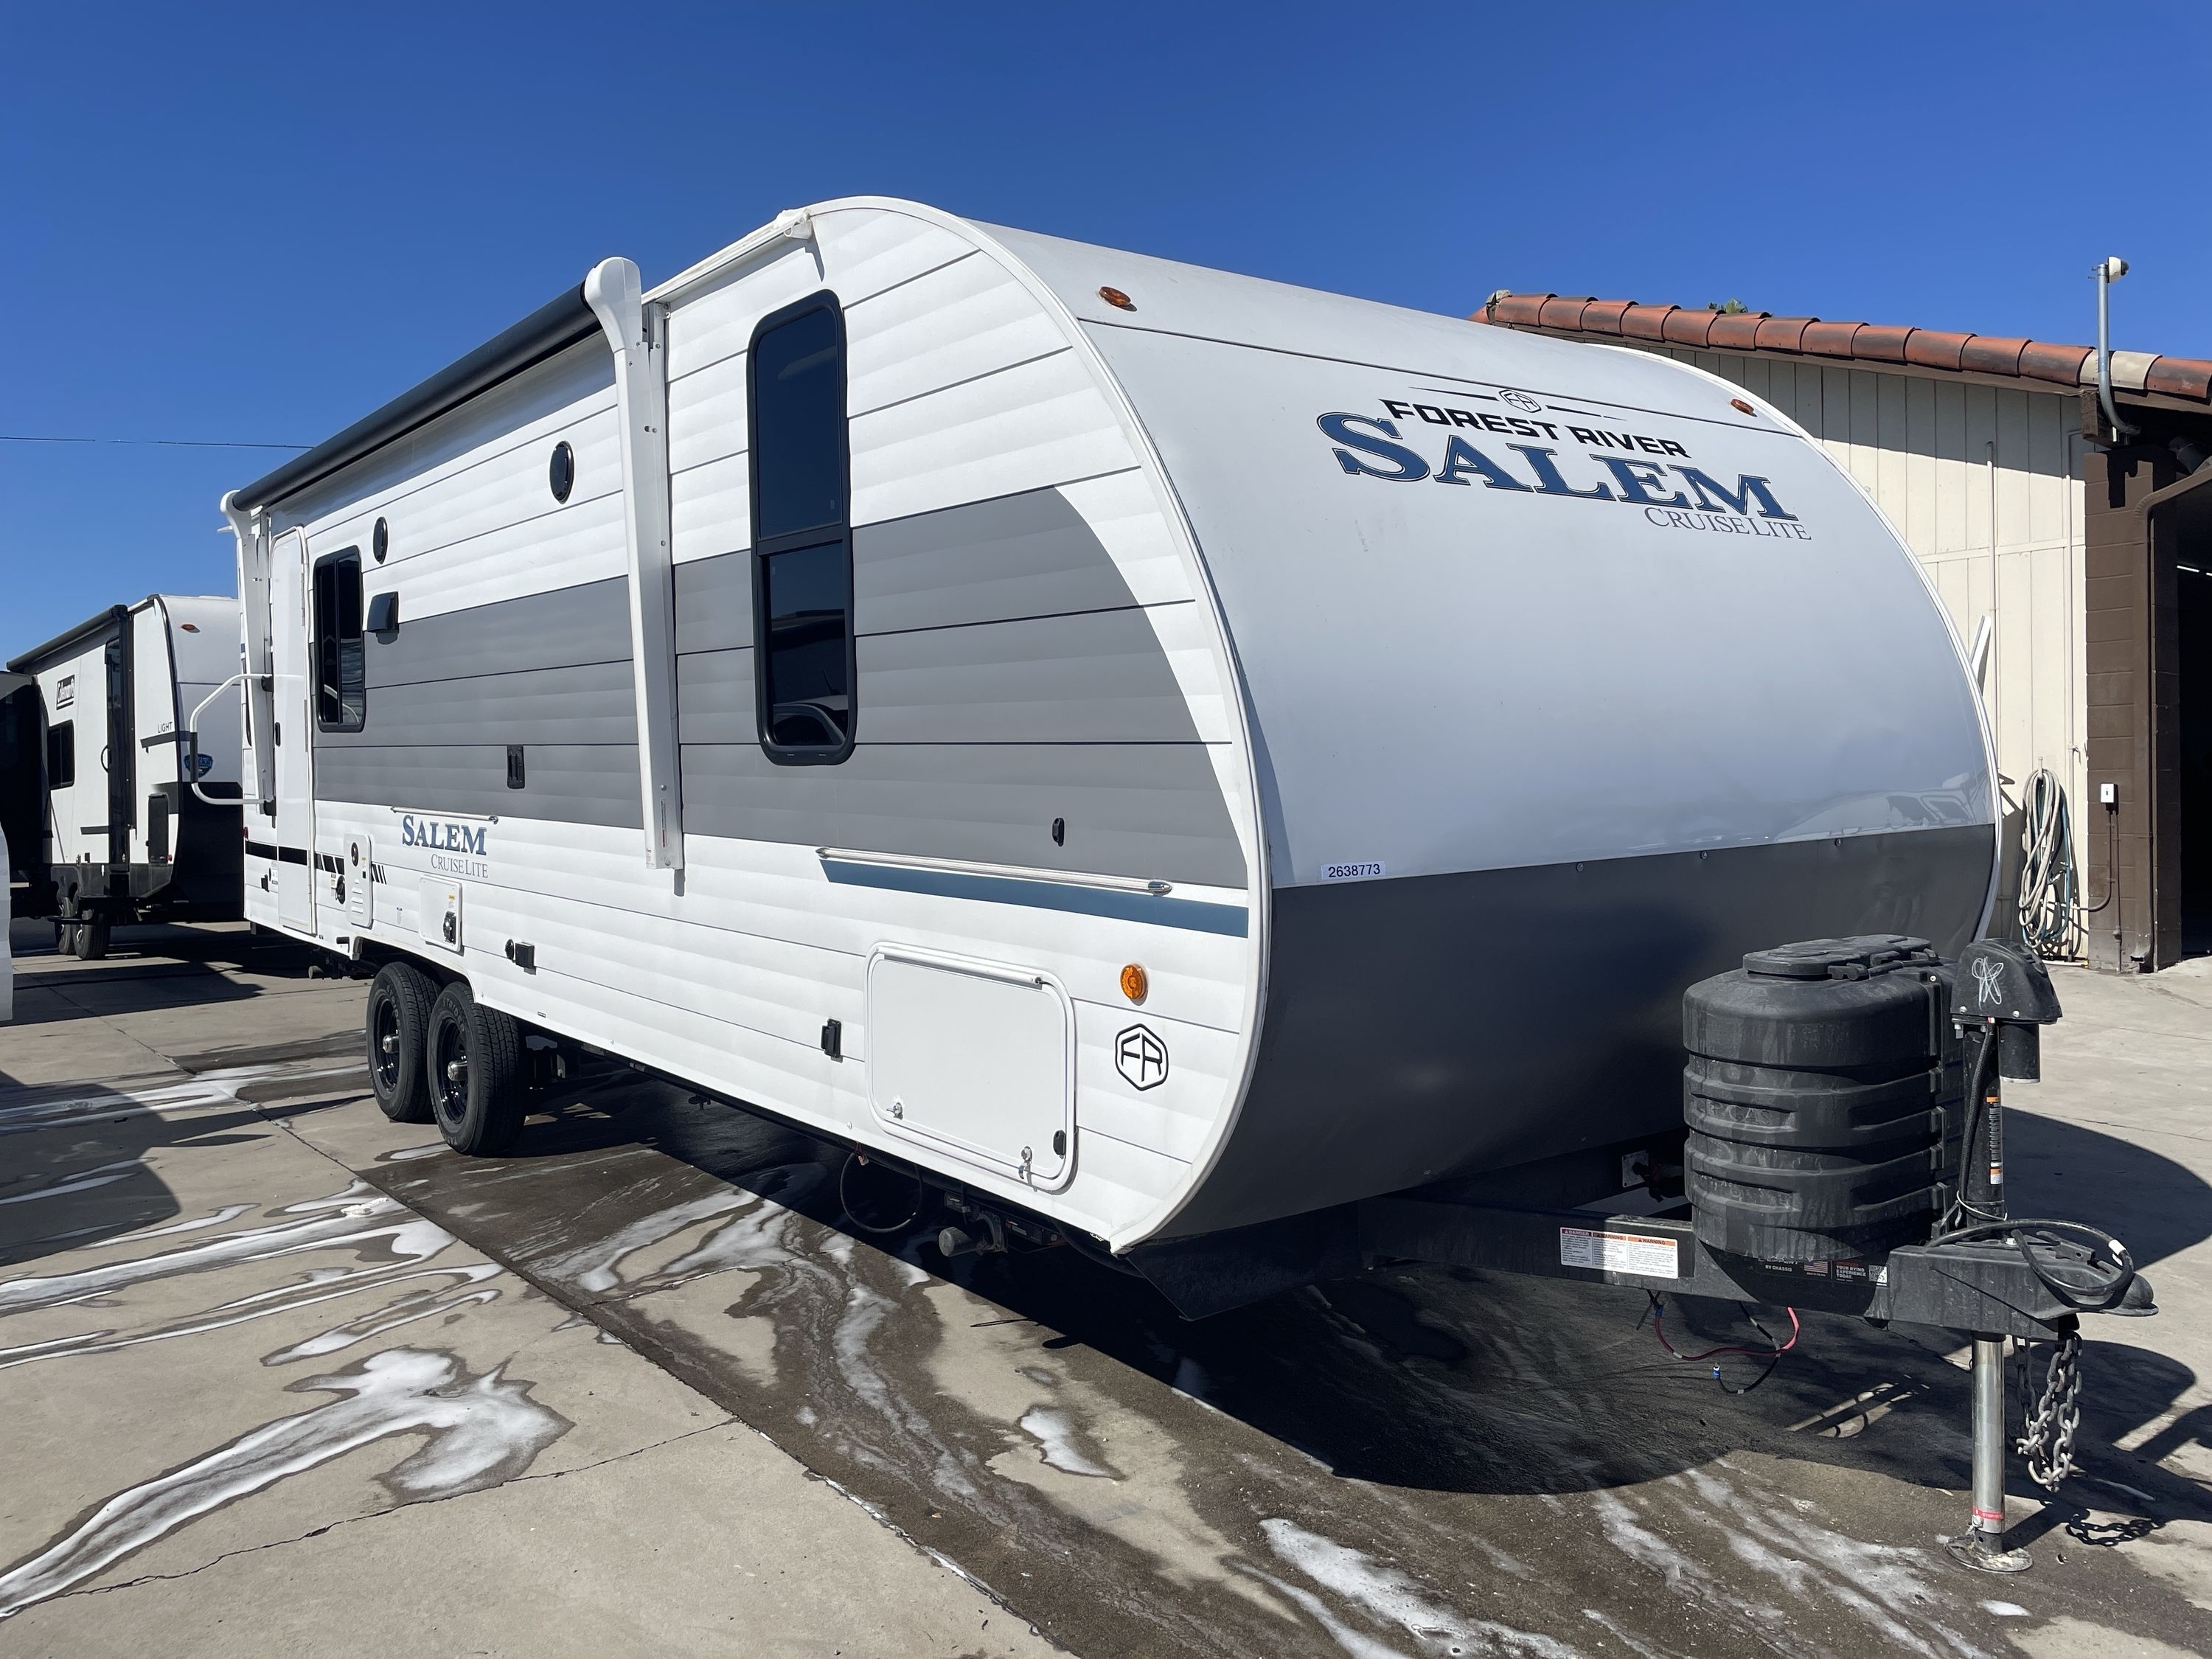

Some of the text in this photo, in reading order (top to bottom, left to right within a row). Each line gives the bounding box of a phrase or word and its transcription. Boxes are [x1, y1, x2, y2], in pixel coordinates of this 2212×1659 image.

[1378, 398, 1693, 459] FOREST RIVER
[1316, 411, 1800, 521] SALEM
[157, 722, 173, 733] LIGHT
[402, 814, 487, 856] SALEM
[1328, 863, 1381, 878] 2638773
